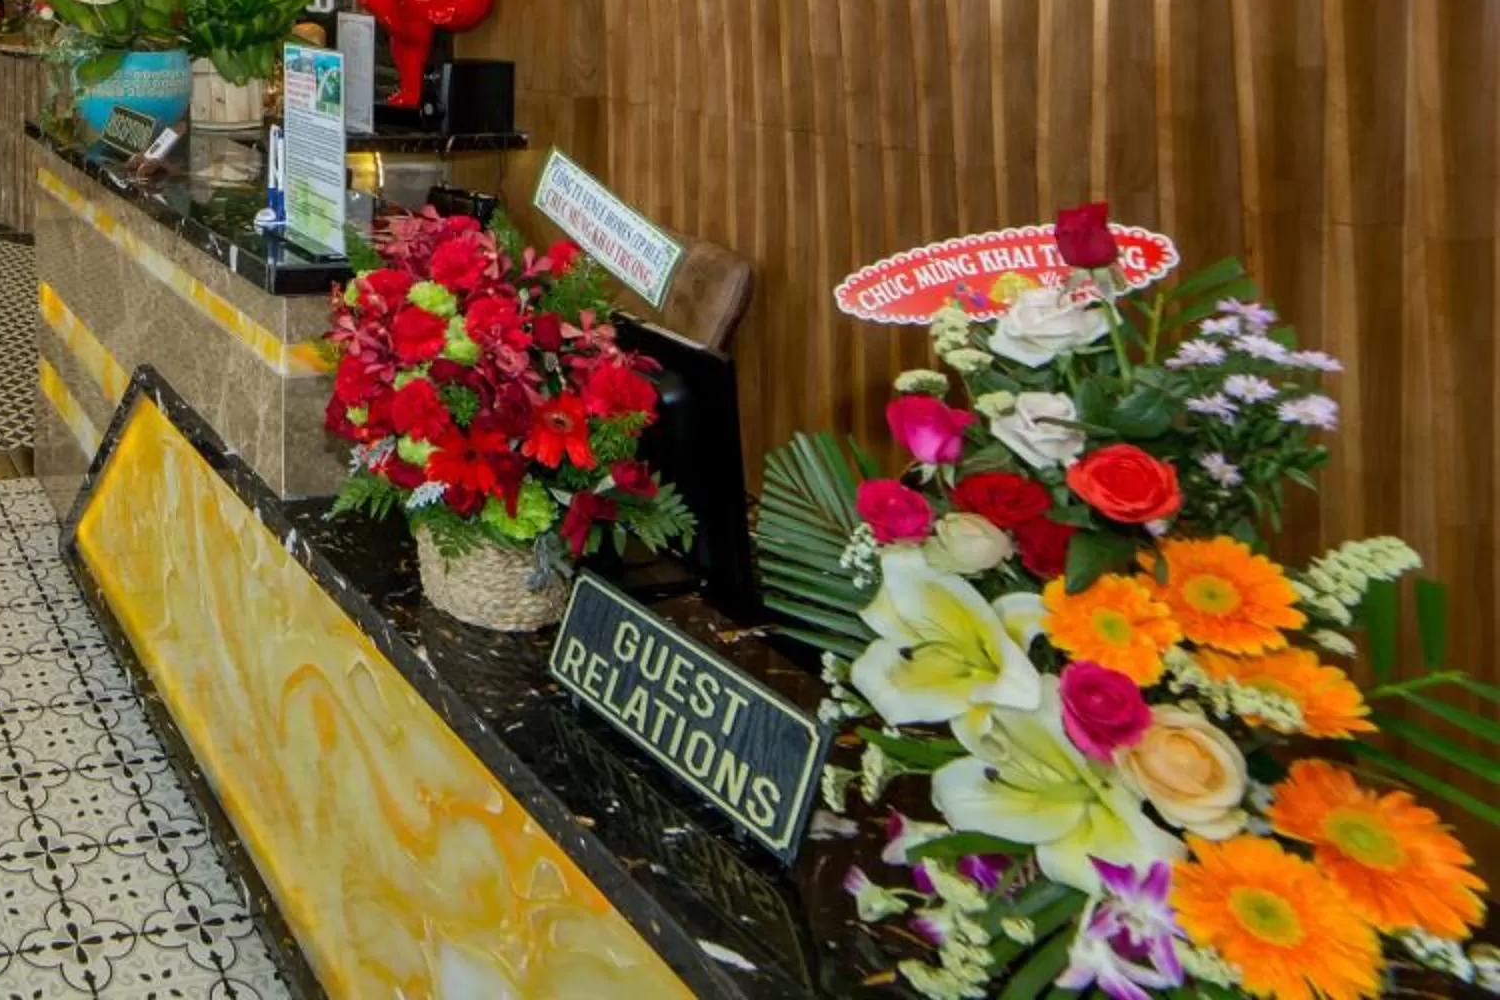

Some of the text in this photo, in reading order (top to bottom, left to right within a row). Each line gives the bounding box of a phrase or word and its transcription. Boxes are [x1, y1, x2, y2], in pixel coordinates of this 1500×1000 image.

[858, 273, 915, 311] CHÚC
[978, 245, 1039, 273] KHAI
[561, 637, 781, 827] RELATIONS
[613, 620, 748, 736] GUEST
